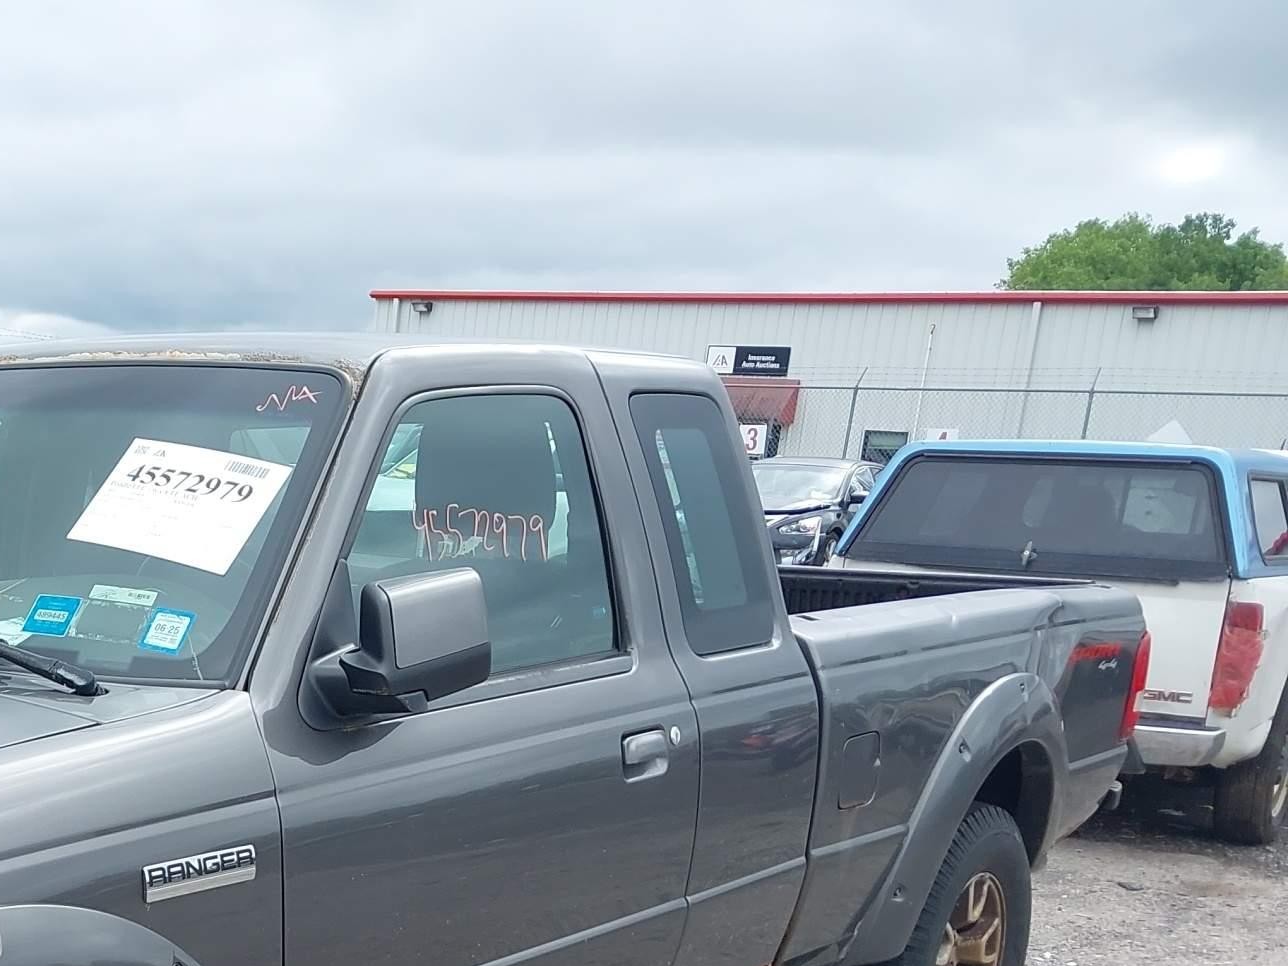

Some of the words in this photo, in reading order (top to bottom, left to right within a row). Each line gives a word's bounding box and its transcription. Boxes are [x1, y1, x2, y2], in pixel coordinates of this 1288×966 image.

[741, 360, 755, 369] Auto
[755, 361, 781, 370] Auctions
[747, 353, 776, 362] Insurance
[745, 427, 759, 451] 3
[126, 463, 254, 504] 45572979
[412, 503, 548, 562] 45572979
[1143, 689, 1193, 704] GMC
[147, 848, 255, 888] RANGER
